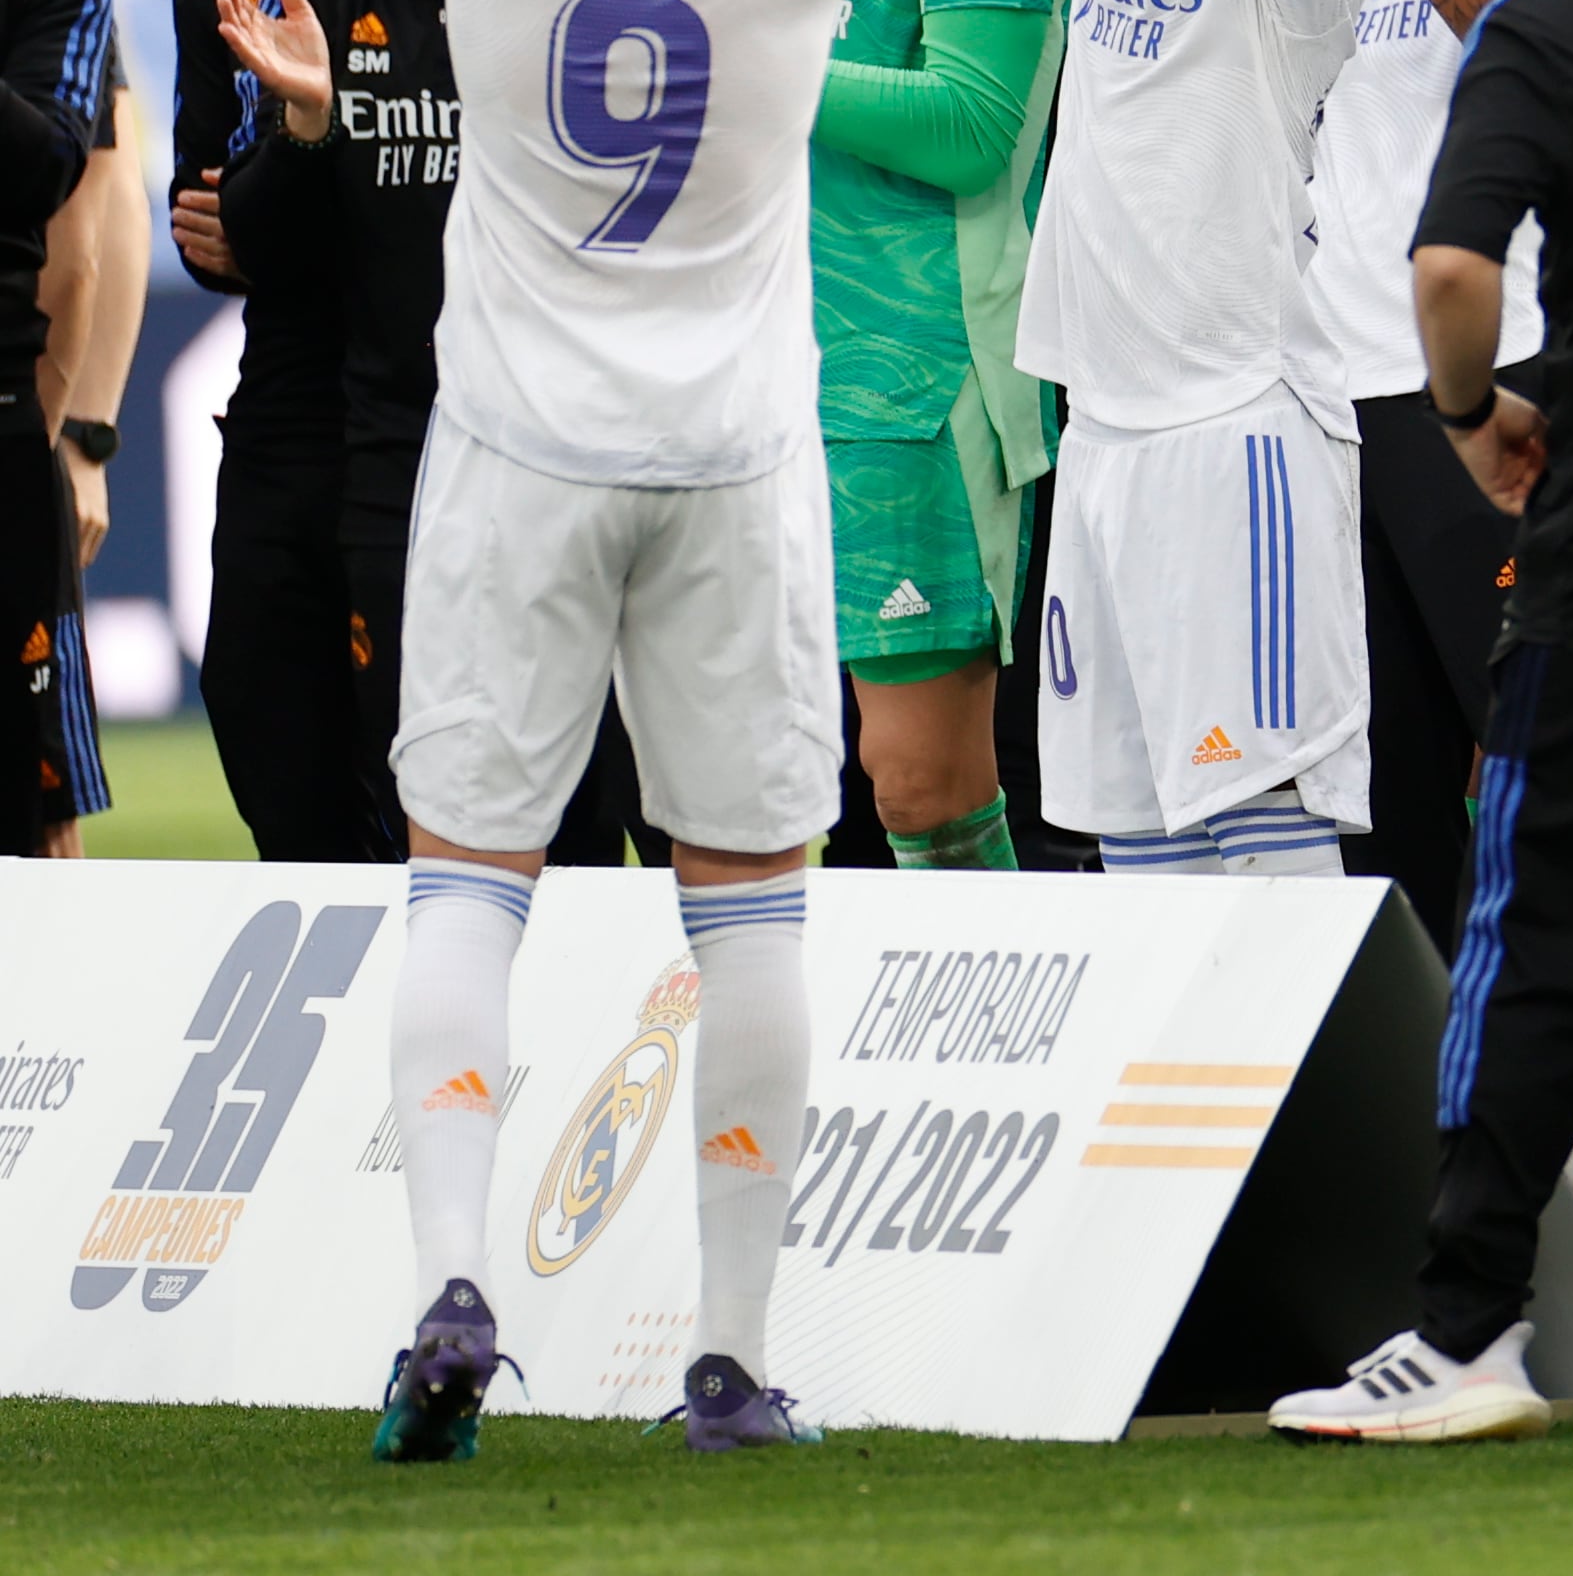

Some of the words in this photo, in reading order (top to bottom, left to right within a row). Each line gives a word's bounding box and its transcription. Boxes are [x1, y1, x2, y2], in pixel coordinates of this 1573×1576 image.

[1090, 3, 1165, 61] BETTER
[347, 47, 392, 74] SM
[375, 144, 415, 187] FLY
[879, 601, 932, 620] adidas
[1191, 748, 1243, 766] adidas
[839, 950, 1092, 1065] TEMPORADA
[79, 1194, 246, 1265] CAMPEONES
[150, 1274, 189, 1300] 2022
